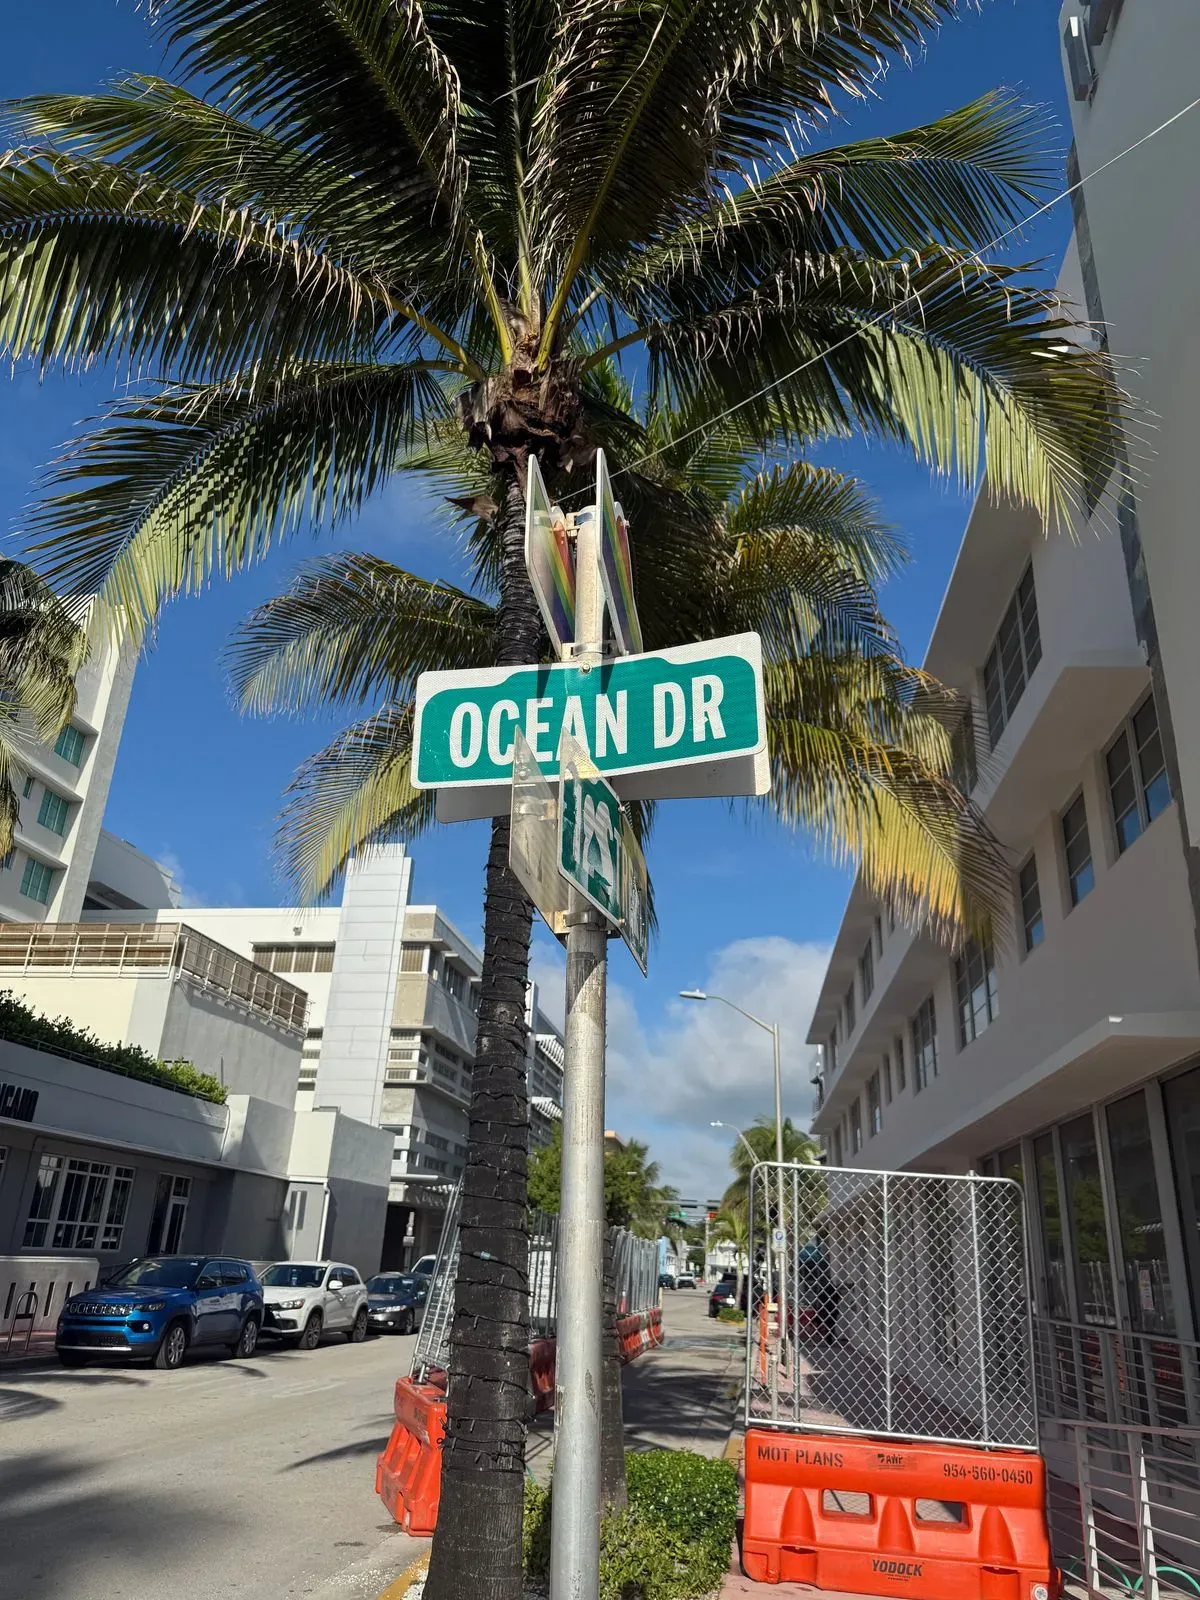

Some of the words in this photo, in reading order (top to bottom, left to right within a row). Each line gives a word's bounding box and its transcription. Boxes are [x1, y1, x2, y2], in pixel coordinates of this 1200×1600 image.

[450, 690, 628, 768] OCEAN
[653, 674, 727, 749] DR
[757, 1445, 790, 1462] MOT
[795, 1449, 844, 1468] PLANS
[943, 1463, 1033, 1485] 954-560-0450
[872, 1559, 922, 1577] YODOCK
